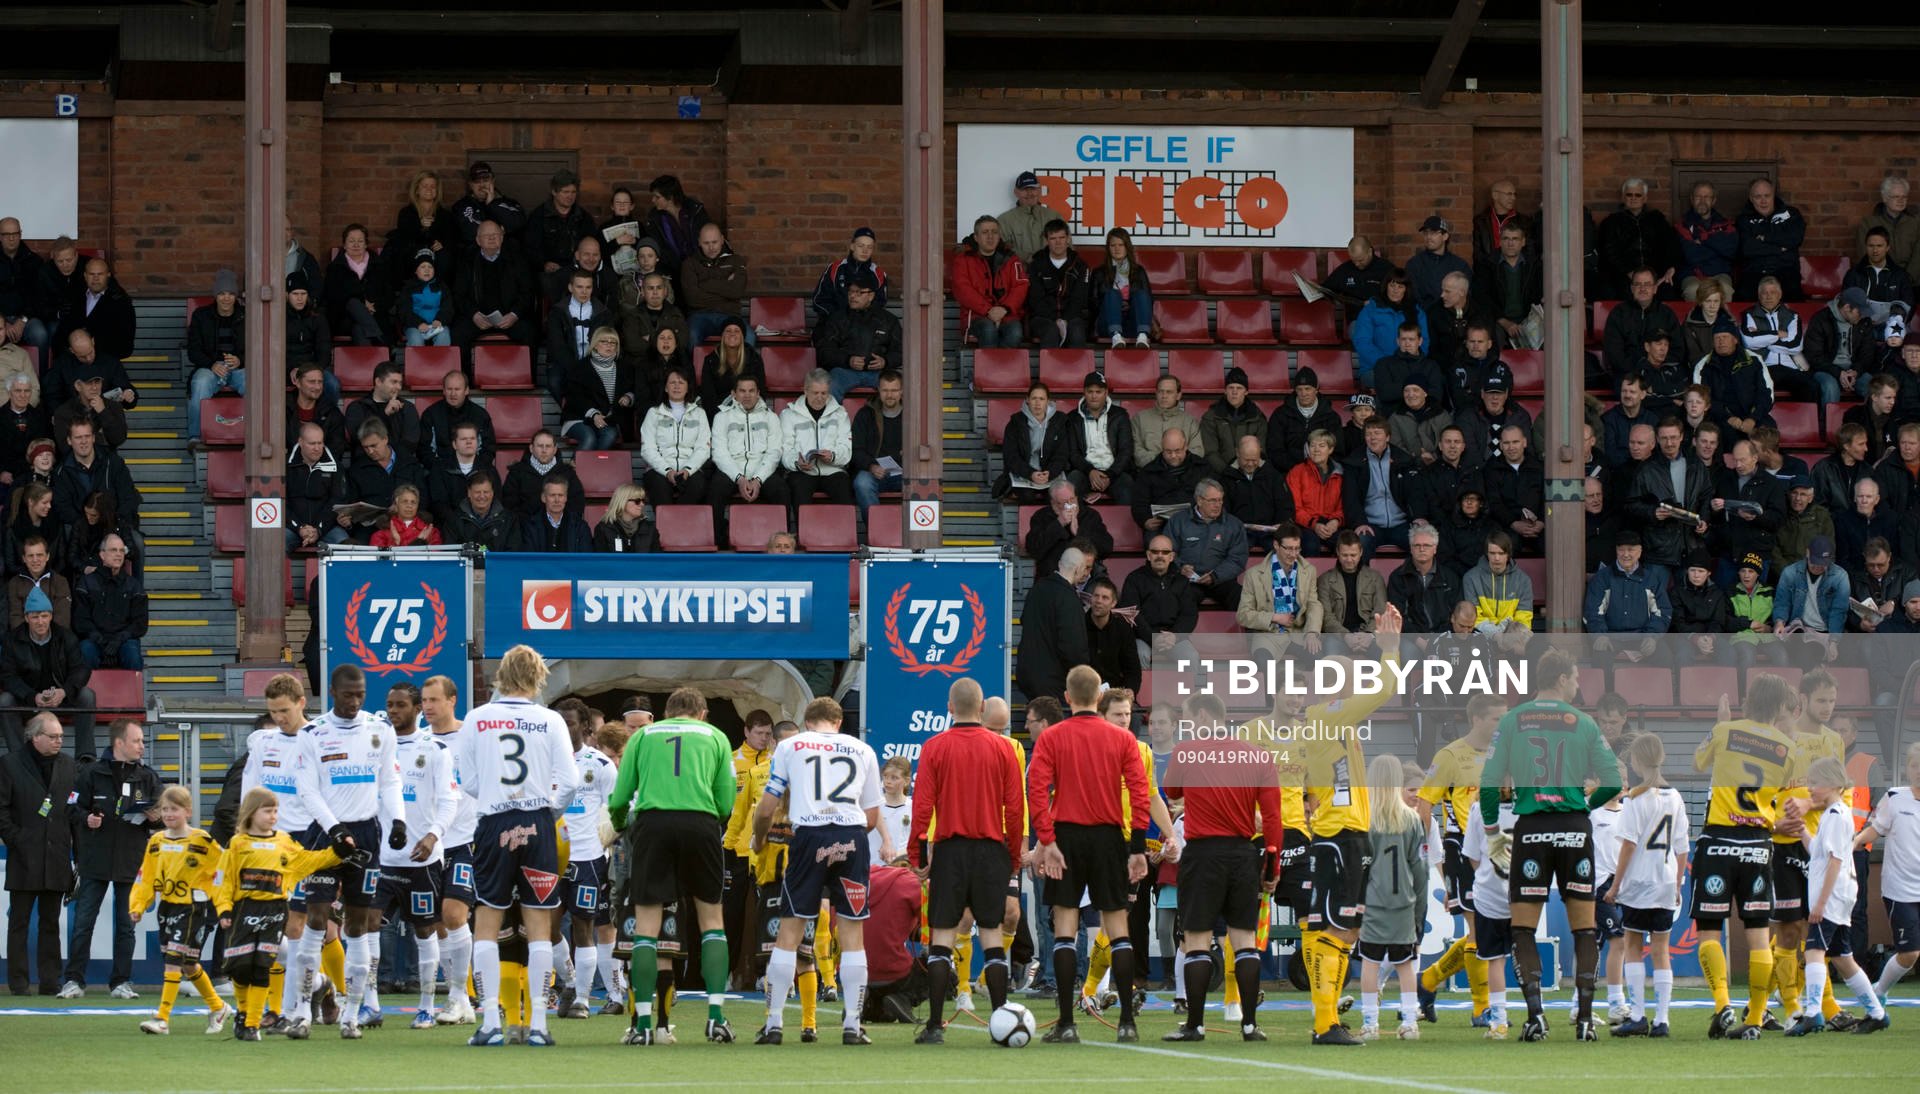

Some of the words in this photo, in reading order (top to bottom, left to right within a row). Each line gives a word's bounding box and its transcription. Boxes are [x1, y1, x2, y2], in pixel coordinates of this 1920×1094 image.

[59, 94, 76, 116] B
[1076, 135, 1188, 163] GEFLE
[1208, 136, 1236, 163] IF
[1034, 175, 1289, 230] BINGO
[369, 598, 425, 644] 75
[584, 587, 806, 624] STRYKTIPSET
[908, 599, 964, 645] 75
[386, 643, 407, 662] år
[925, 644, 945, 662] år
[909, 710, 955, 732] Stol
[329, 765, 375, 777] SANDVIK
[498, 733, 529, 786] 3
[665, 735, 682, 777] 1
[1528, 736, 1566, 788] 31
[805, 754, 857, 805] 12
[1736, 760, 1764, 812] 2
[1522, 832, 1587, 844] COOPER
[1552, 840, 1586, 848] TIRES
[1646, 814, 1673, 864] 4
[1384, 845, 1399, 895] 1
[173, 929, 182, 941] 2
[1606, 917, 1614, 929] 9
[1899, 928, 1905, 938] 7
